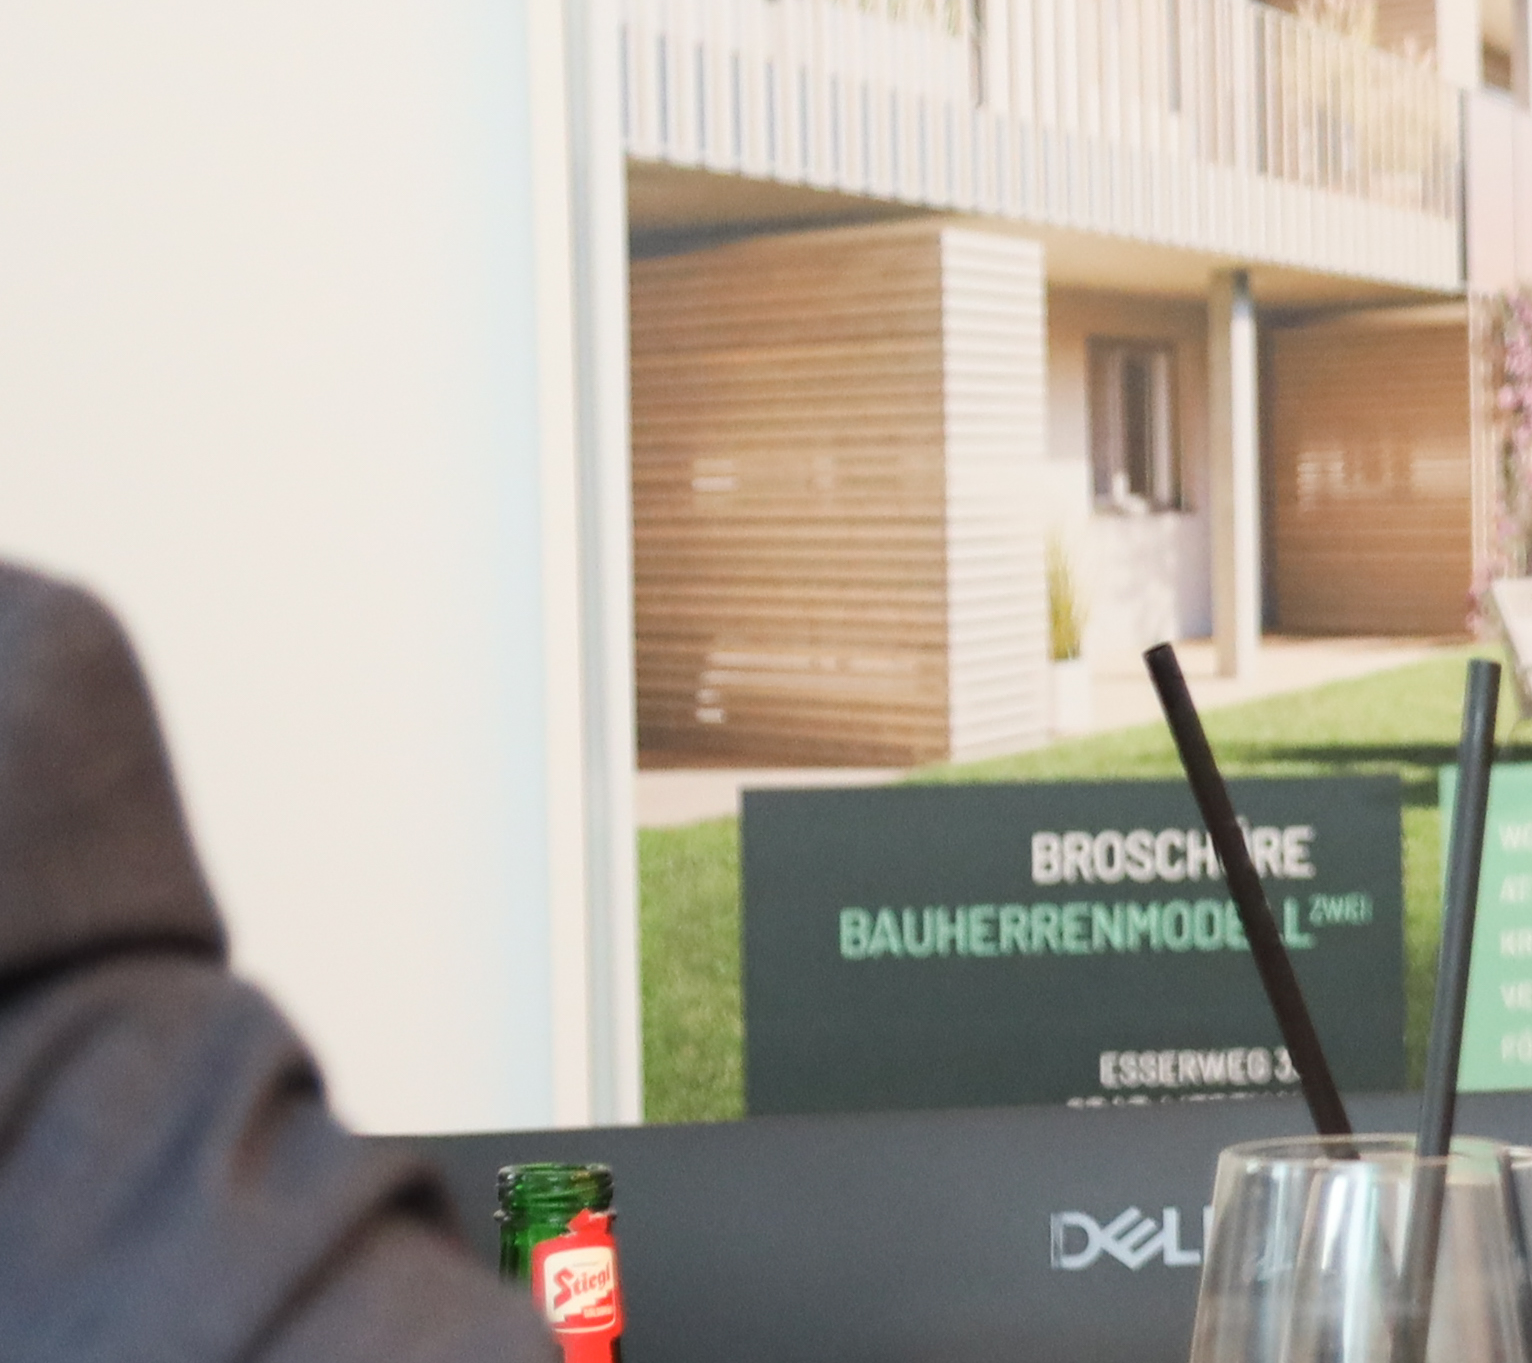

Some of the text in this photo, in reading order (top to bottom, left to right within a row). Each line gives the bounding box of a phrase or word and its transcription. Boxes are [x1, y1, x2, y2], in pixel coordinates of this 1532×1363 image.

[1031, 816, 1317, 885] BROSCHRE
[839, 895, 1316, 960] BAUHERRENMODEL
[553, 1262, 611, 1310] Stiegl
